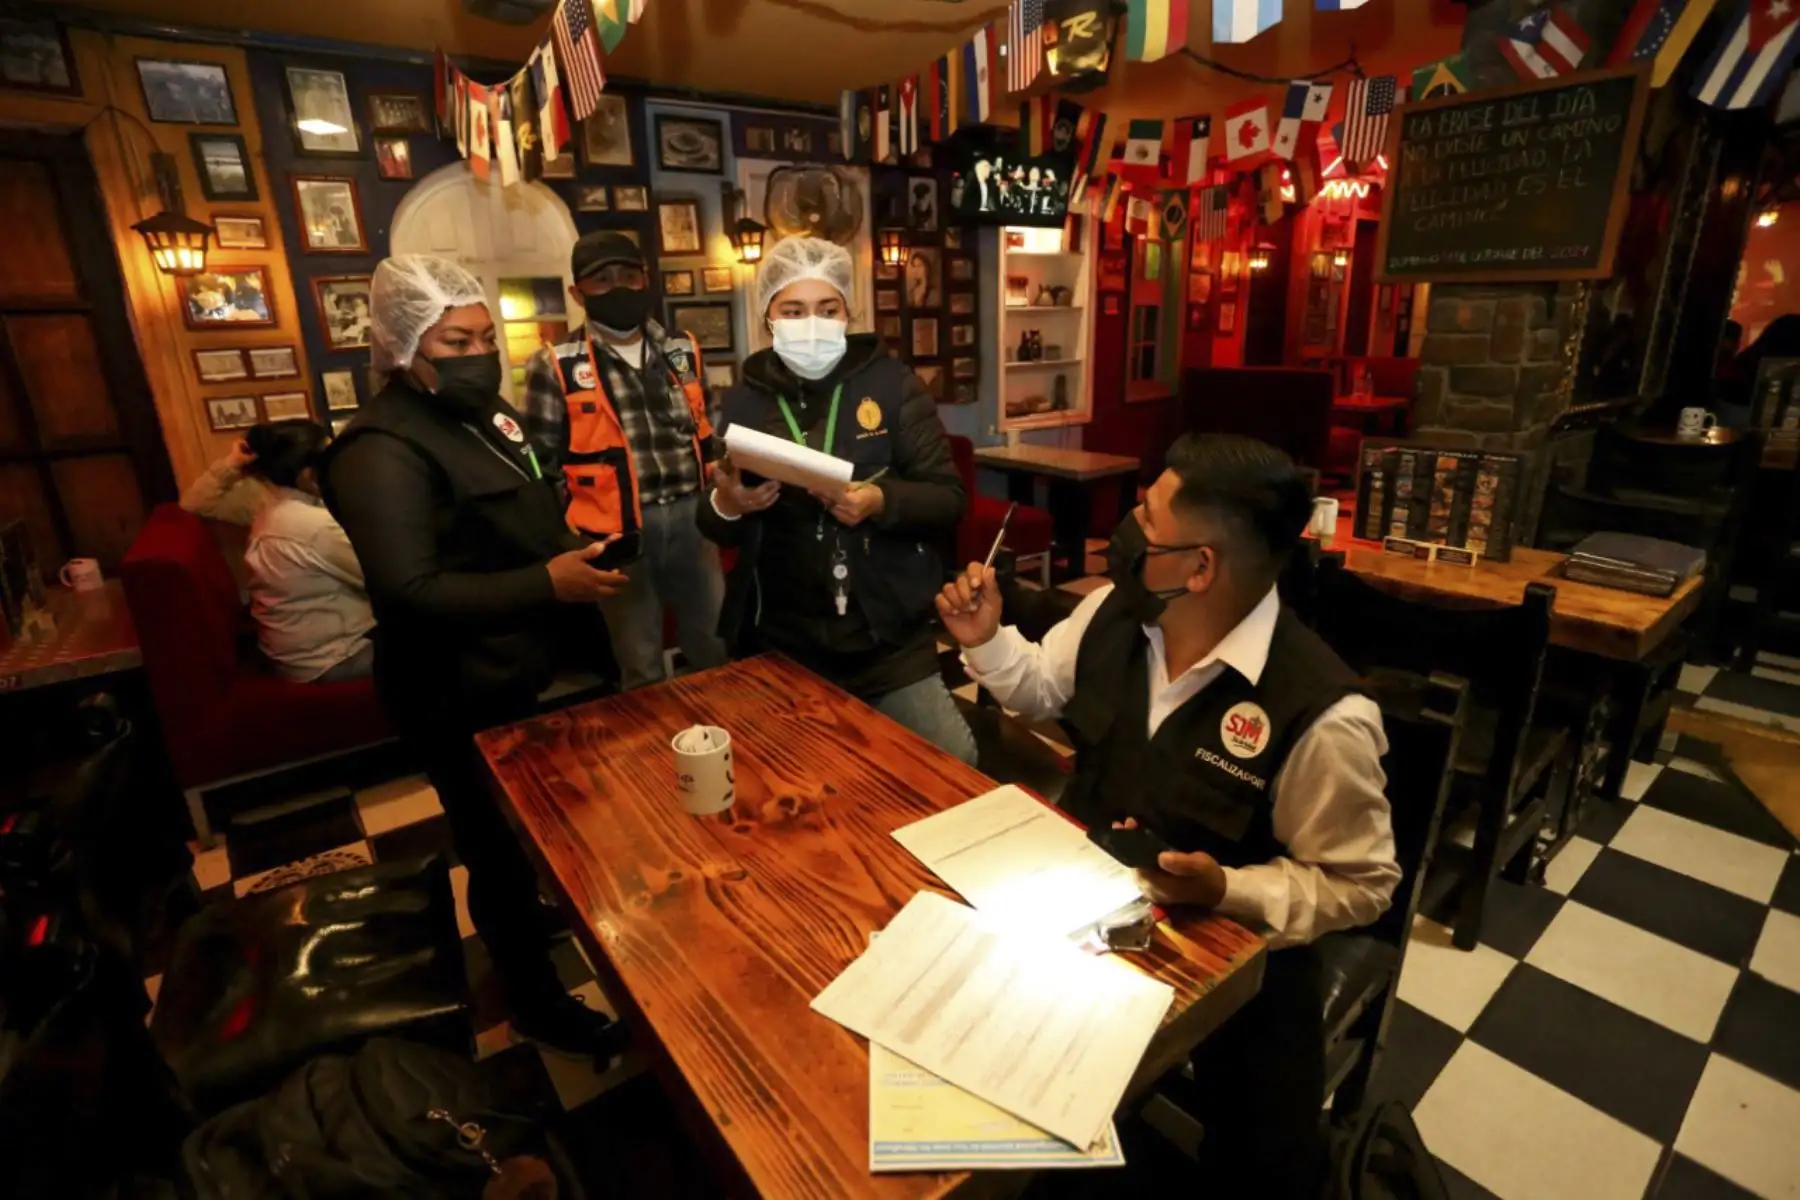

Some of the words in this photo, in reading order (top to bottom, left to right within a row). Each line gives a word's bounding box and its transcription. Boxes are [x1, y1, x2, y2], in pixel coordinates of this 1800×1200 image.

[1501, 94, 1540, 121] DEL
[1501, 128, 1529, 147] UN
[1194, 747, 1267, 791] FISCALIZADOR
